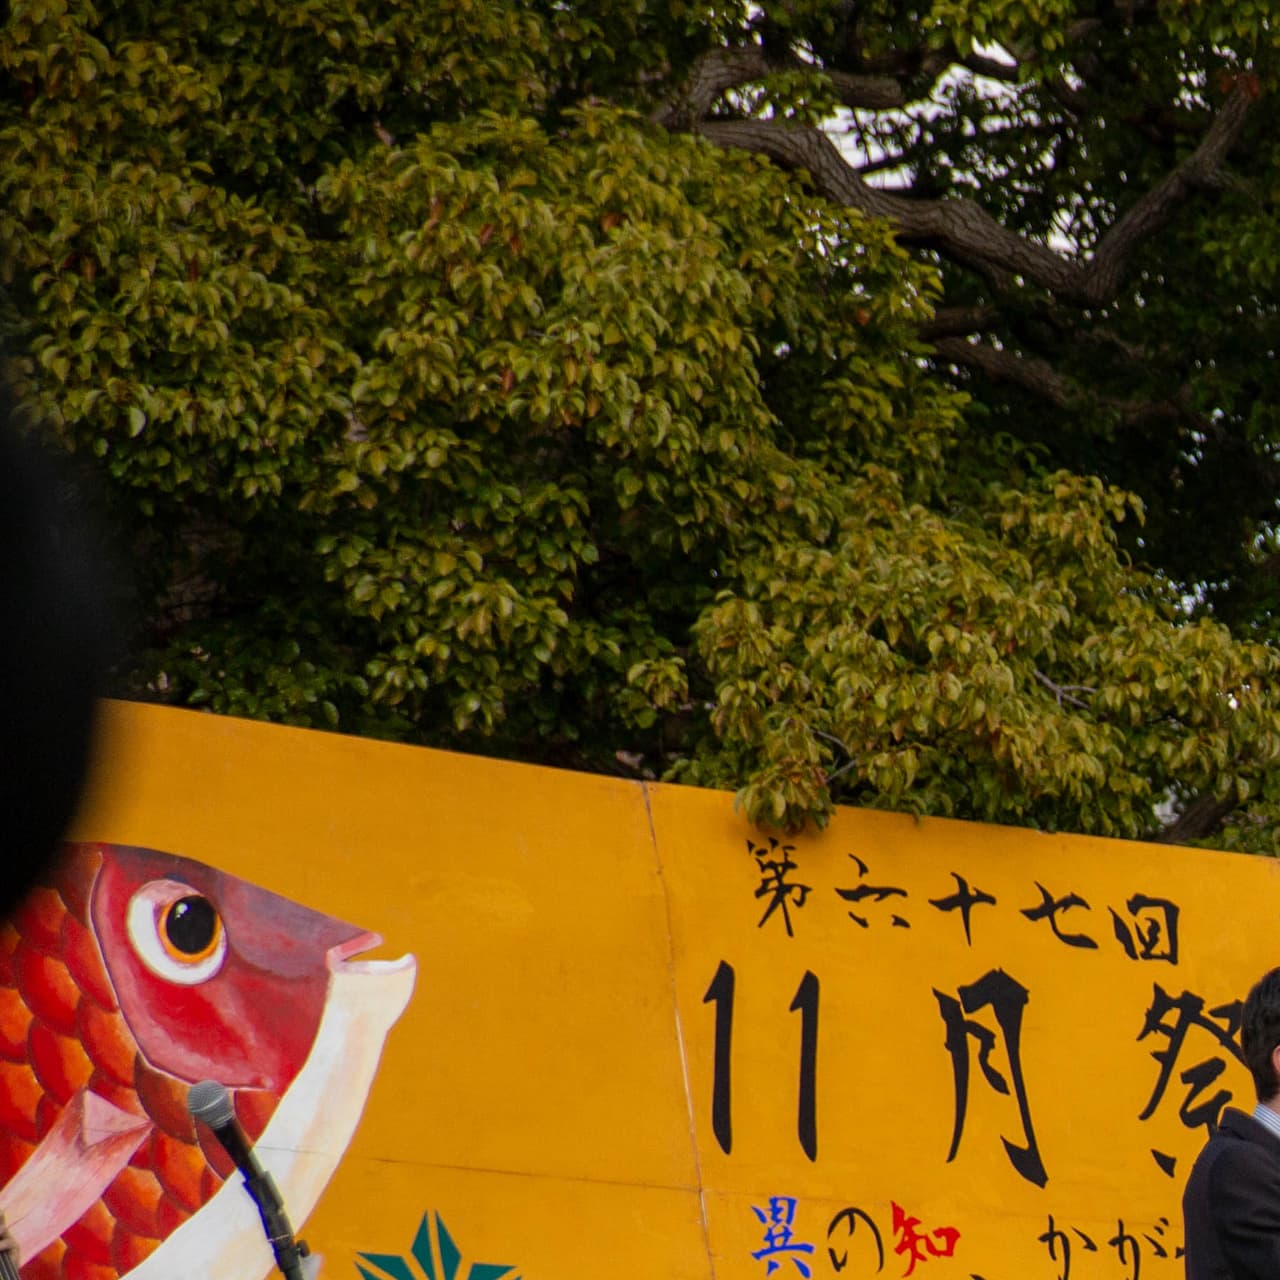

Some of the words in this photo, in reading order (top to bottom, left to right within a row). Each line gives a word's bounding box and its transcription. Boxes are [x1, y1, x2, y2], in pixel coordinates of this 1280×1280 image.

[746, 836, 1181, 966] 第六十七回
